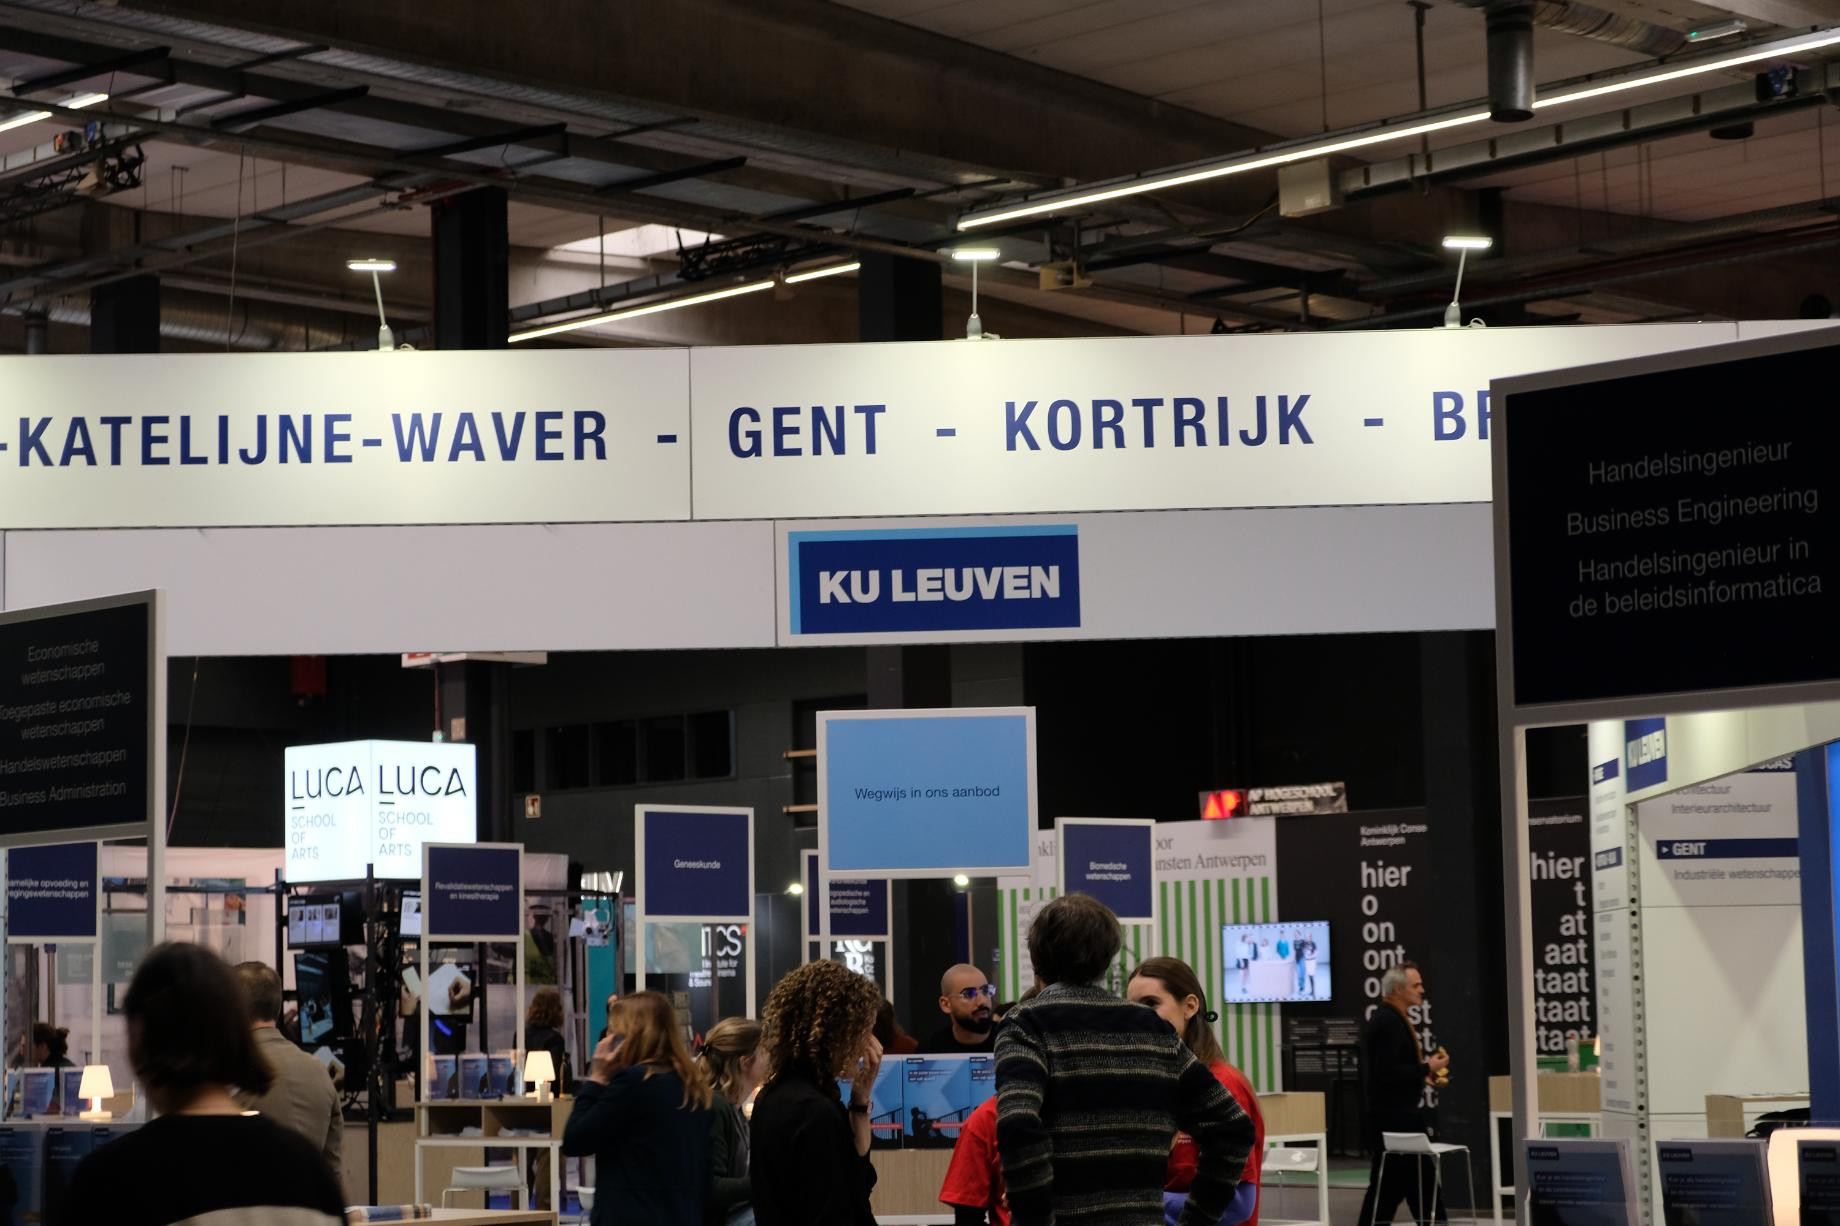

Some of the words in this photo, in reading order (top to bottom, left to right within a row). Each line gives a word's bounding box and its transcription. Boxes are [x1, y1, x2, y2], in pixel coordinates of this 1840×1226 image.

[728, 405, 886, 459] GENT
[1004, 394, 1314, 452] KORTRIJK
[1588, 440, 1792, 485] Handelsingenieur
[1567, 506, 1669, 536] Business
[1678, 487, 1818, 525] Engineering
[1578, 542, 1781, 583] Handelsingenieur
[1789, 537, 1809, 559] in
[819, 569, 880, 604] KU
[891, 565, 1060, 602] LEUVEN
[1569, 594, 1598, 618] de
[1605, 572, 1822, 614] beleidsinformatica
[28, 638, 99, 662] Economische
[21, 661, 105, 686] wetenschappen
[59, 690, 131, 713] economische
[21, 717, 105, 741] wetenschappen
[0, 748, 127, 775] Handelswetenschappen
[292, 765, 365, 799] LUCA
[379, 764, 466, 797] LUCA
[0, 790, 46, 807] Business
[49, 780, 126, 801] Administration
[855, 787, 906, 801] Wegwijs
[911, 787, 921, 798] in
[925, 788, 948, 798] ons
[952, 786, 1000, 797] aanbod
[1203, 790, 1240, 820] AP
[379, 811, 433, 825] SCHOOL
[1671, 803, 1772, 814] Interieurarchitectuur
[291, 814, 337, 829] SCHOOL
[379, 827, 396, 840] OF
[1360, 823, 1399, 836] Koninklijk
[291, 831, 306, 845] OF
[379, 843, 412, 856] ARTS
[1361, 836, 1405, 847] Antwerpen
[1672, 841, 1707, 856] GENT
[291, 846, 319, 860] ARTS
[674, 859, 721, 870] Geneeskunde
[1194, 852, 1267, 872] Antwerpen
[1085, 872, 1131, 882] wetenschappen
[1089, 861, 1127, 872] Biomedische
[1361, 860, 1411, 889] hier
[1531, 851, 1586, 881] hier
[1674, 868, 1726, 881] Industriële
[1728, 868, 1801, 881] wetenschappe
[40, 878, 78, 889] opvoeding
[79, 880, 89, 888] en
[1573, 880, 1586, 907] t
[1361, 894, 1379, 917] o
[1362, 920, 1395, 943] on
[1560, 909, 1588, 936] at
[1363, 944, 1406, 972] ont
[1545, 938, 1589, 966] aat
[1534, 967, 1590, 994] taat
